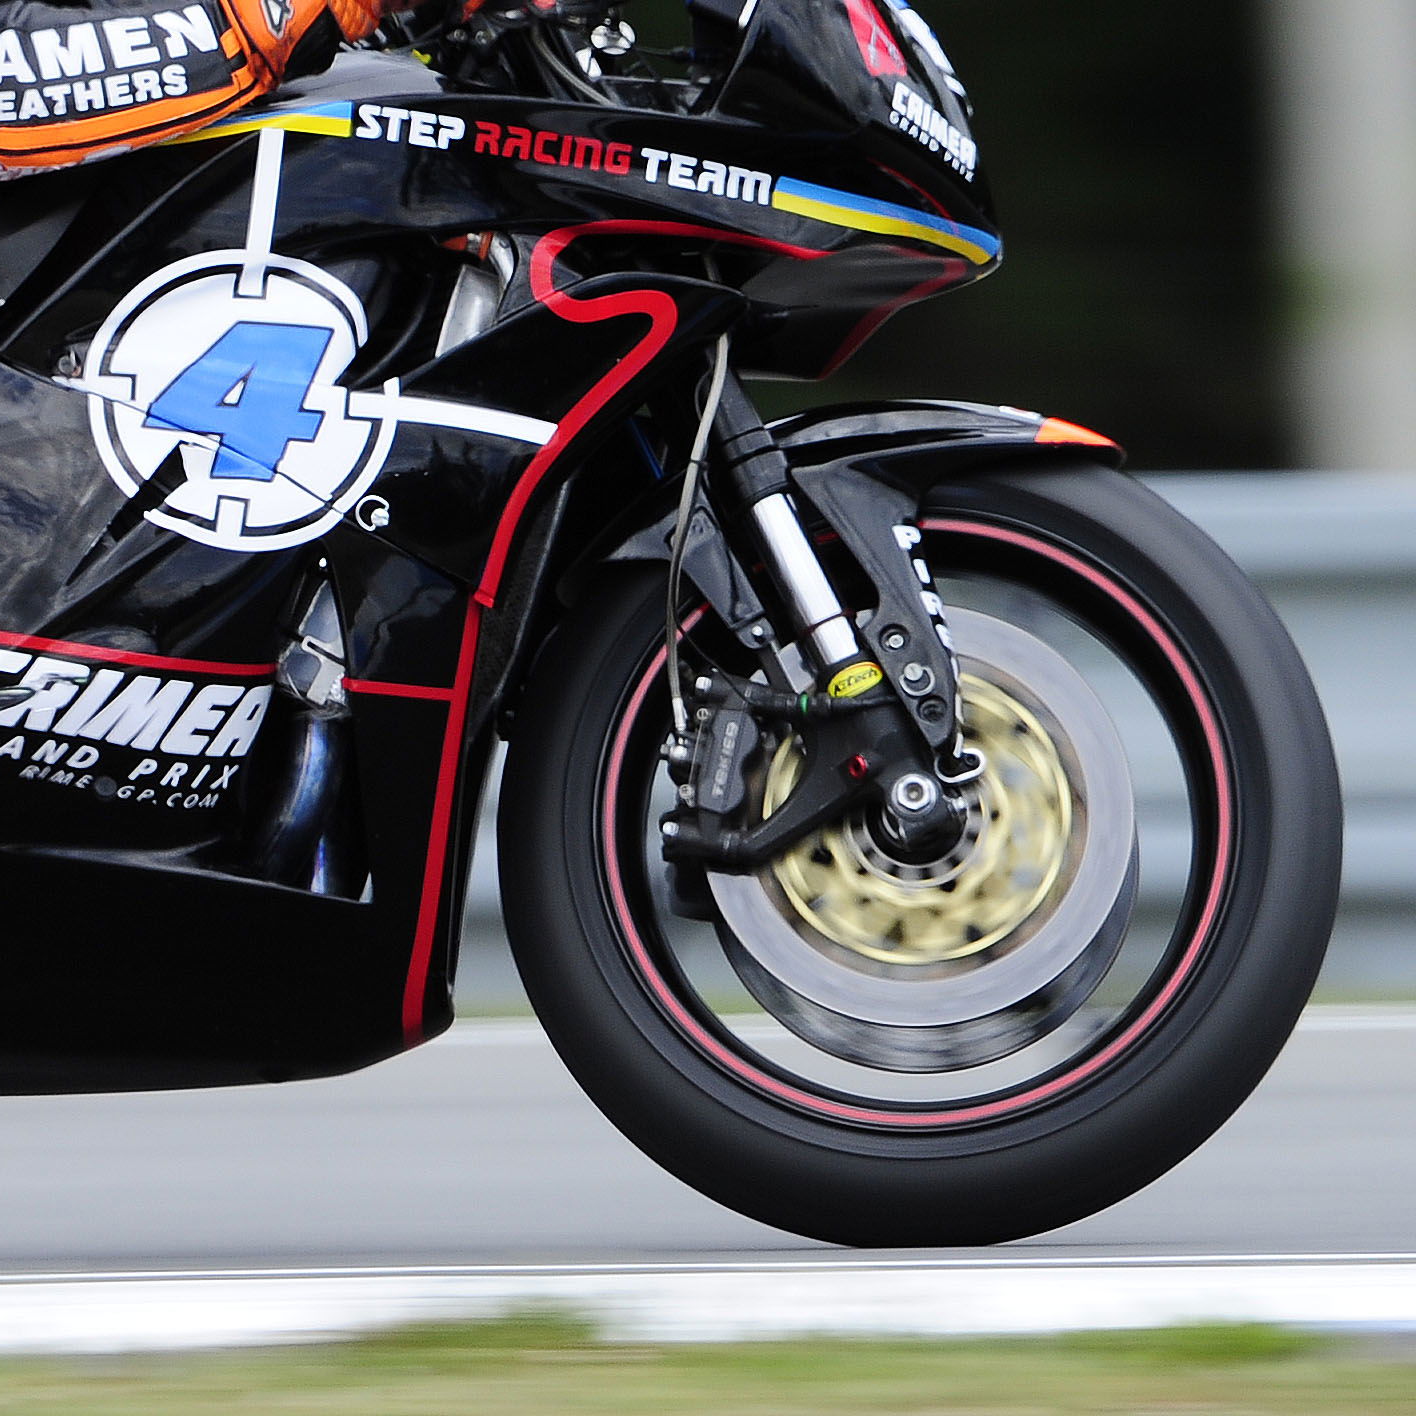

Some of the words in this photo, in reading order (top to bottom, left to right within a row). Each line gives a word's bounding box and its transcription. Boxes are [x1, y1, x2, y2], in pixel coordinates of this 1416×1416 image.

[355, 104, 466, 150] STEP
[474, 120, 633, 175] RACING
[641, 147, 773, 206] TEAM
[892, 81, 977, 171] CRIMEA
[143, 321, 335, 482] 4
[127, 758, 239, 790] PRIX
